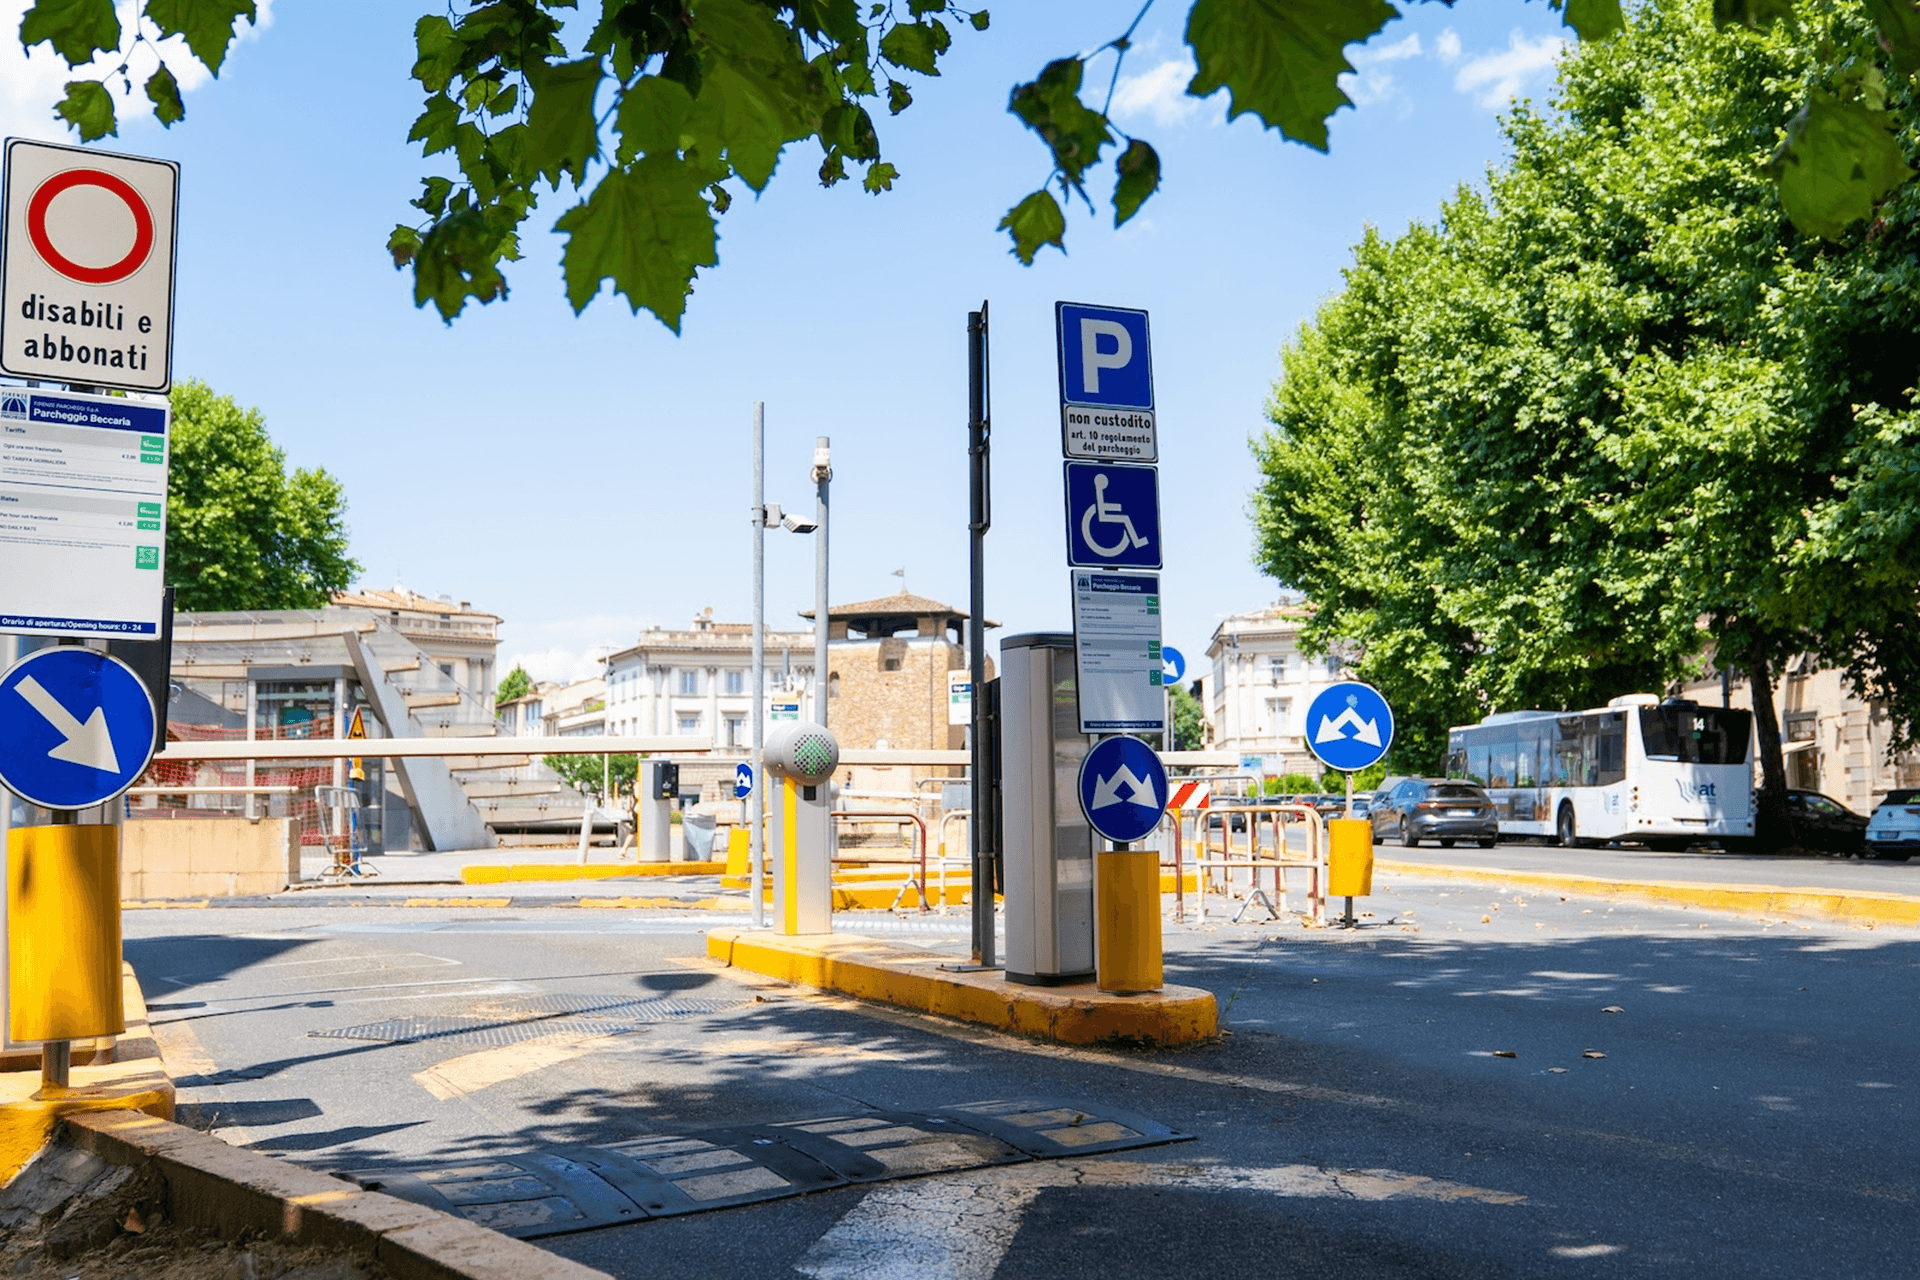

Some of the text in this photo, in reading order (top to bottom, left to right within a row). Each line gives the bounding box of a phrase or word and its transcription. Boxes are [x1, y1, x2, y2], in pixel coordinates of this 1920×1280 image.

[21, 293, 152, 334] disabili e
[24, 333, 147, 370] abbonati
[1080, 318, 1132, 393] P
[33, 408, 131, 426] Parcheggio Beccaria
[1069, 413, 1151, 429] non custodito
[1071, 430, 1150, 444] art. 10 regolamento
[1082, 442, 1140, 455] del parcheggio
[2, 617, 25, 626] Orario
[35, 620, 97, 631] apertura/Opening
[98, 622, 121, 630] hours:
[1693, 717, 1705, 731] 14
[1699, 783, 1716, 797] at
